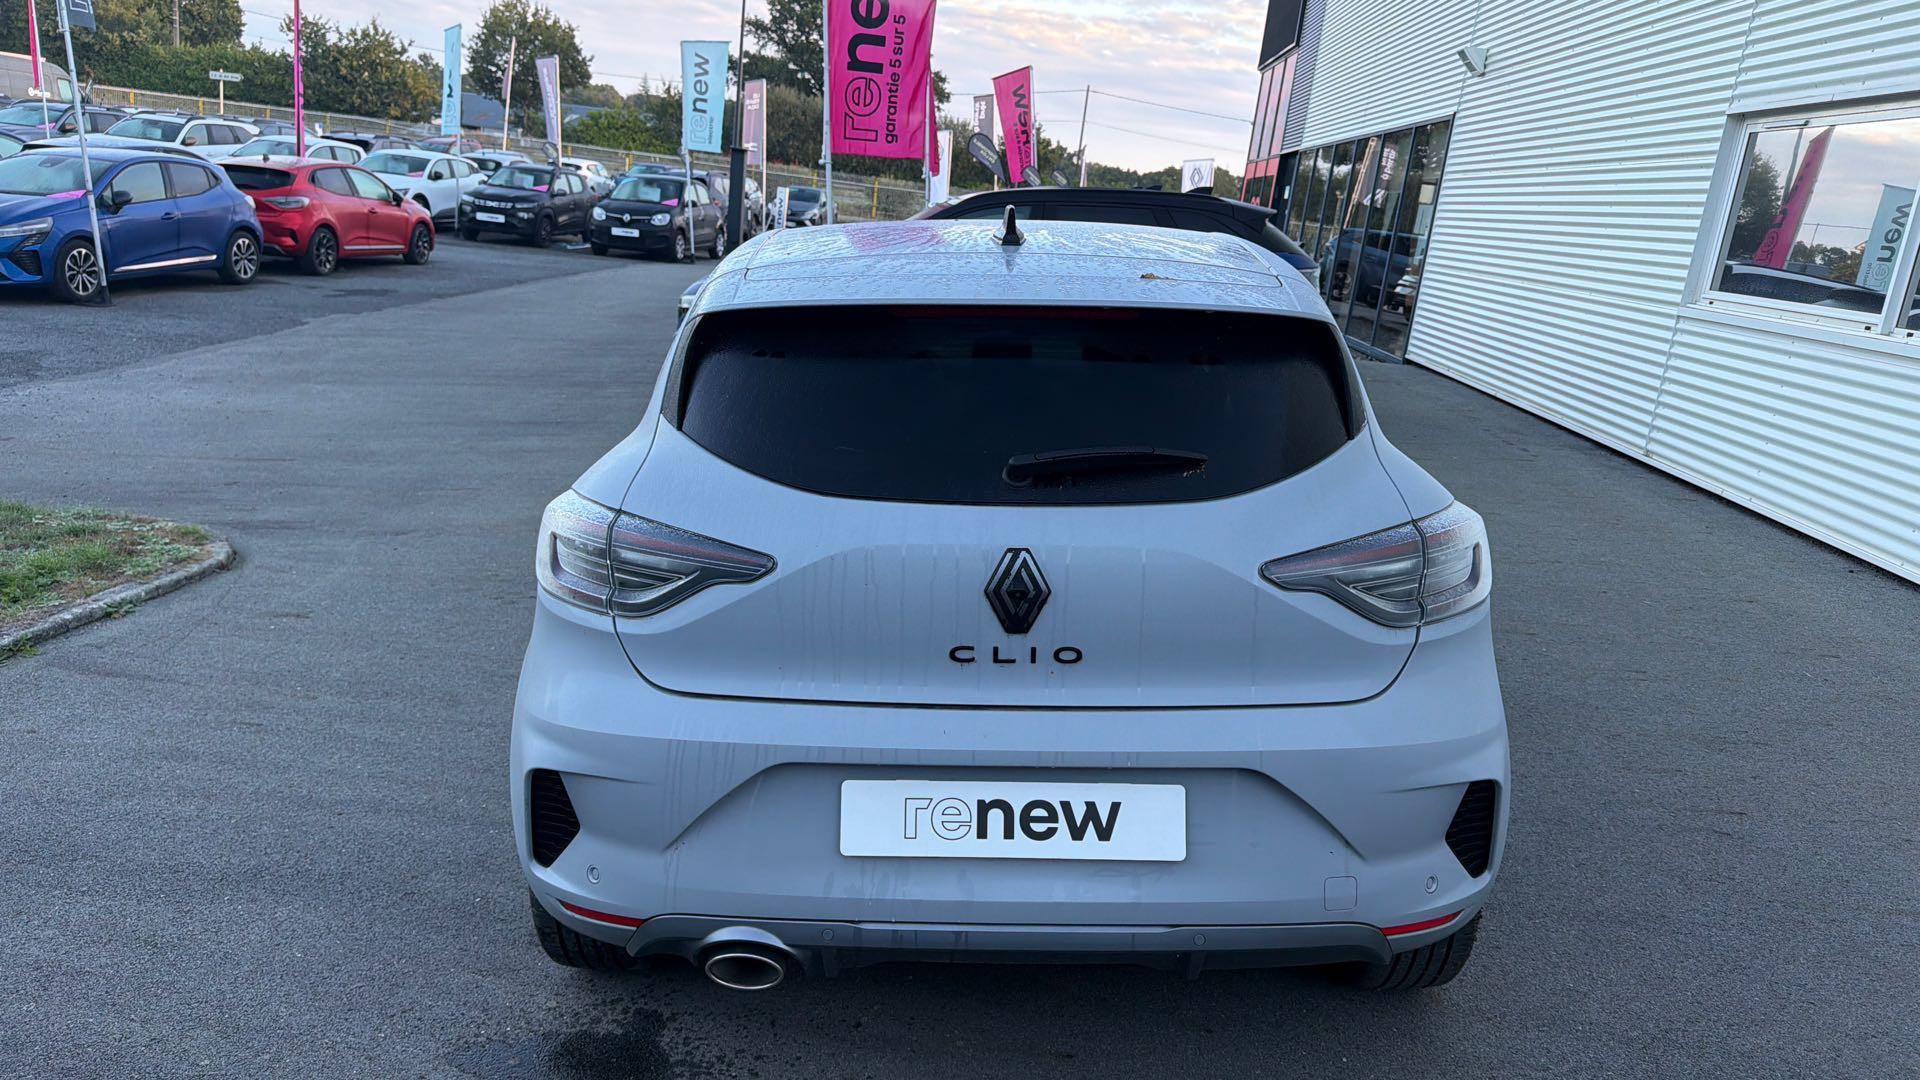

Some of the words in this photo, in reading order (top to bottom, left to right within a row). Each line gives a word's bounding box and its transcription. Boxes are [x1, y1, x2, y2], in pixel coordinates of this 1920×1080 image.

[894, 14, 906, 25] 5
[892, 27, 904, 56] sur
[889, 58, 902, 69] 5
[690, 51, 709, 144] renew
[884, 72, 901, 146] garantie
[949, 645, 1083, 664] CLIO
[904, 796, 1122, 842] renew
